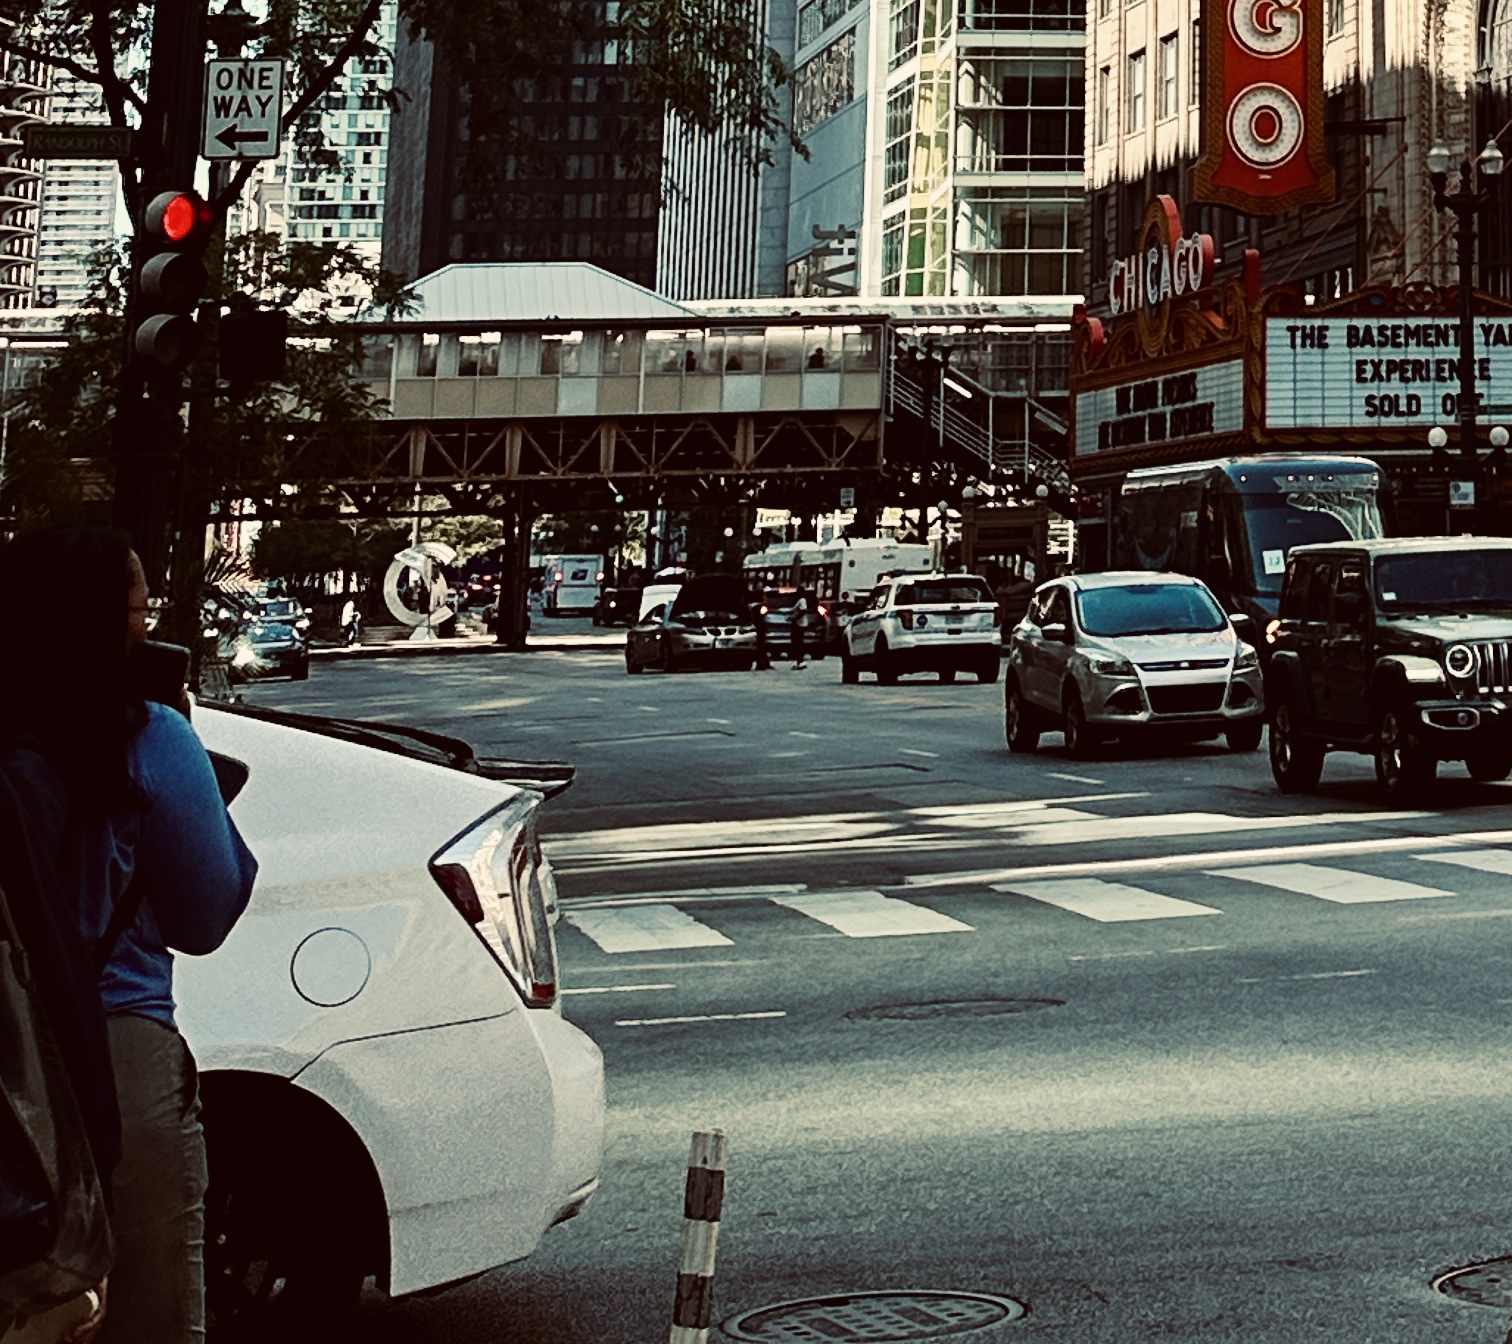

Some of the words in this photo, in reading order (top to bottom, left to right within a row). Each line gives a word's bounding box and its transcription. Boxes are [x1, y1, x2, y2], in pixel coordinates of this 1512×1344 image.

[216, 67, 274, 90] ONE
[213, 95, 274, 119] WAY
[1109, 232, 1203, 315] CHICAGO
[1287, 325, 1329, 349] THE
[1347, 324, 1462, 348] BASEMENT
[1356, 358, 1491, 383] EXPERIENE
[1365, 394, 1421, 418] SOLD
